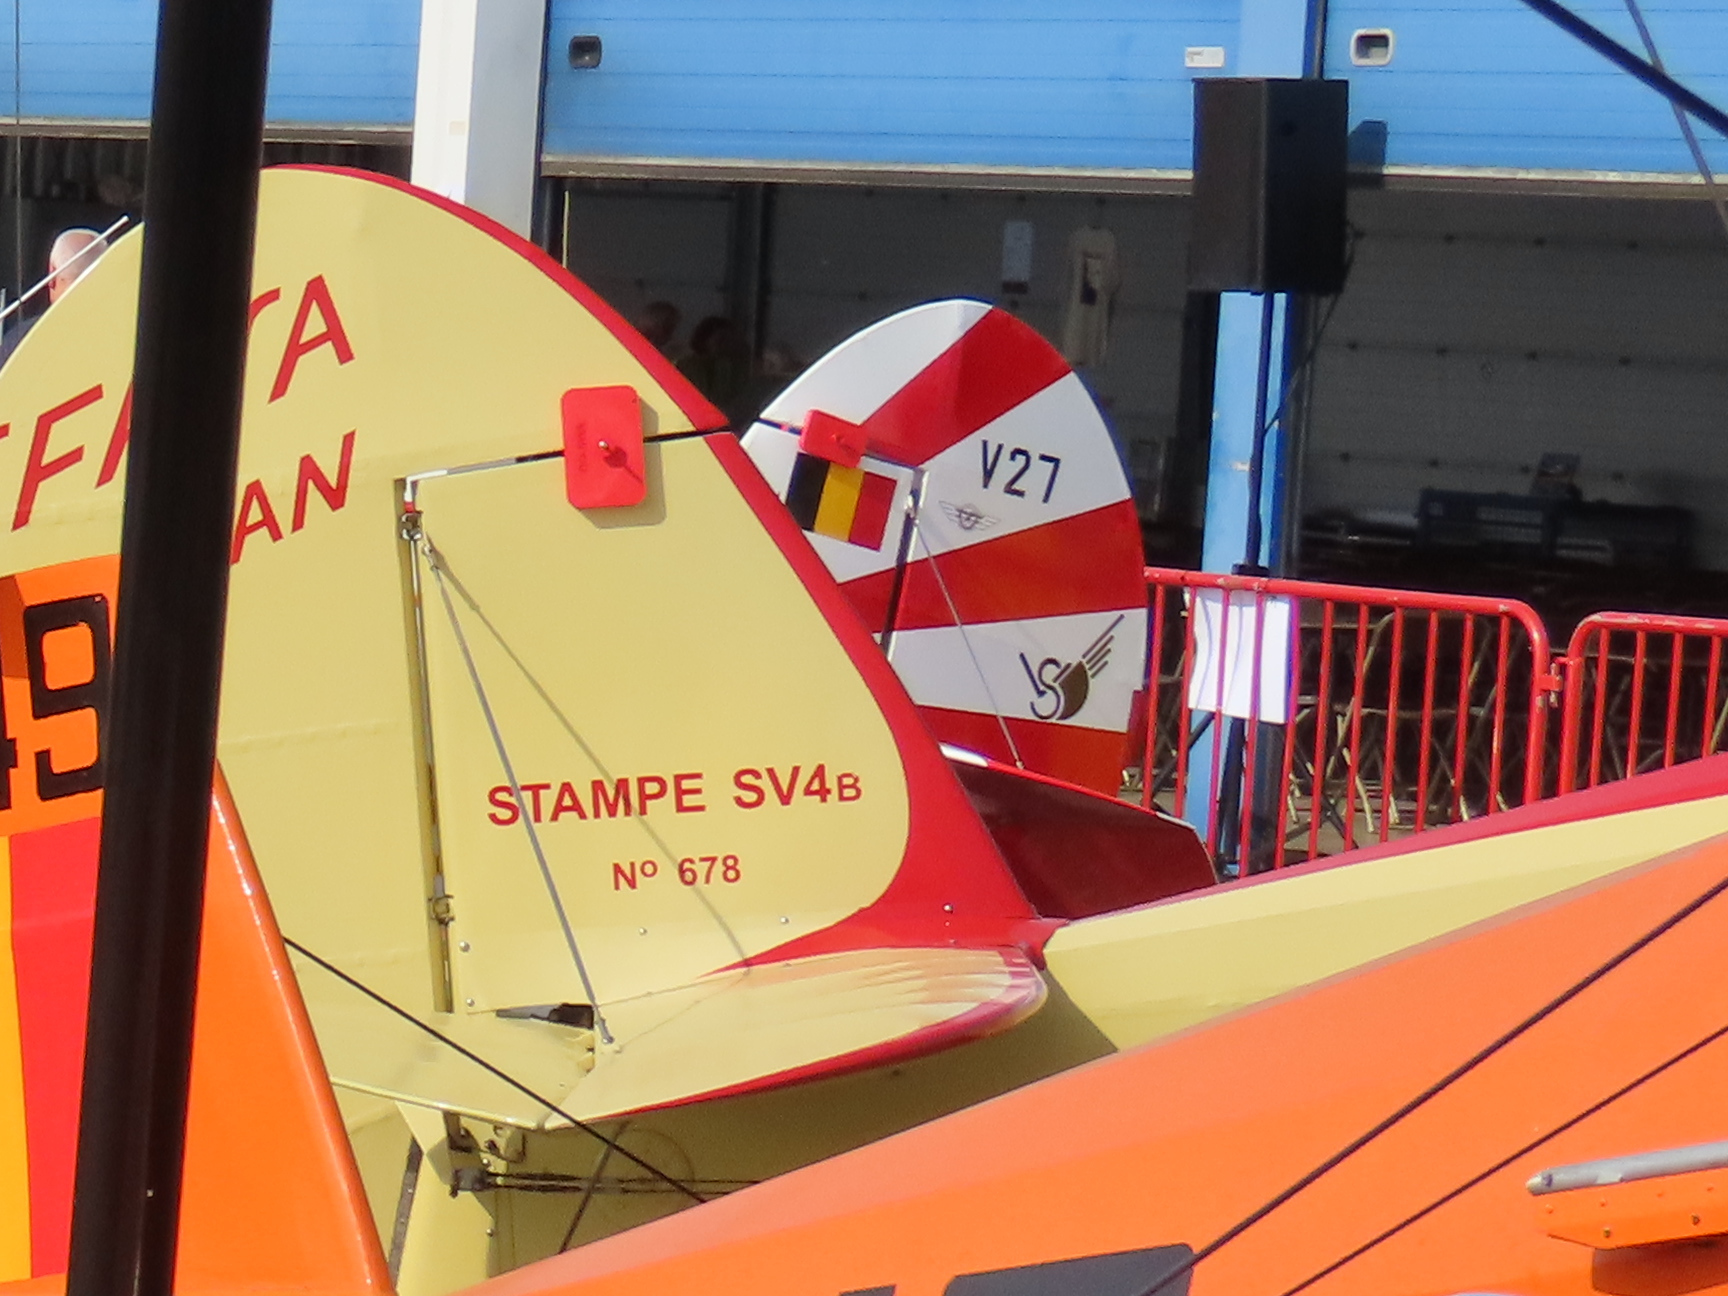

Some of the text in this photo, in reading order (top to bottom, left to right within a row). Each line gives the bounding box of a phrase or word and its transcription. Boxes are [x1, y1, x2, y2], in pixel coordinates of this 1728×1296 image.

[981, 439, 1061, 504] V27
[487, 772, 707, 826] STAMPE
[678, 854, 742, 887] 678
